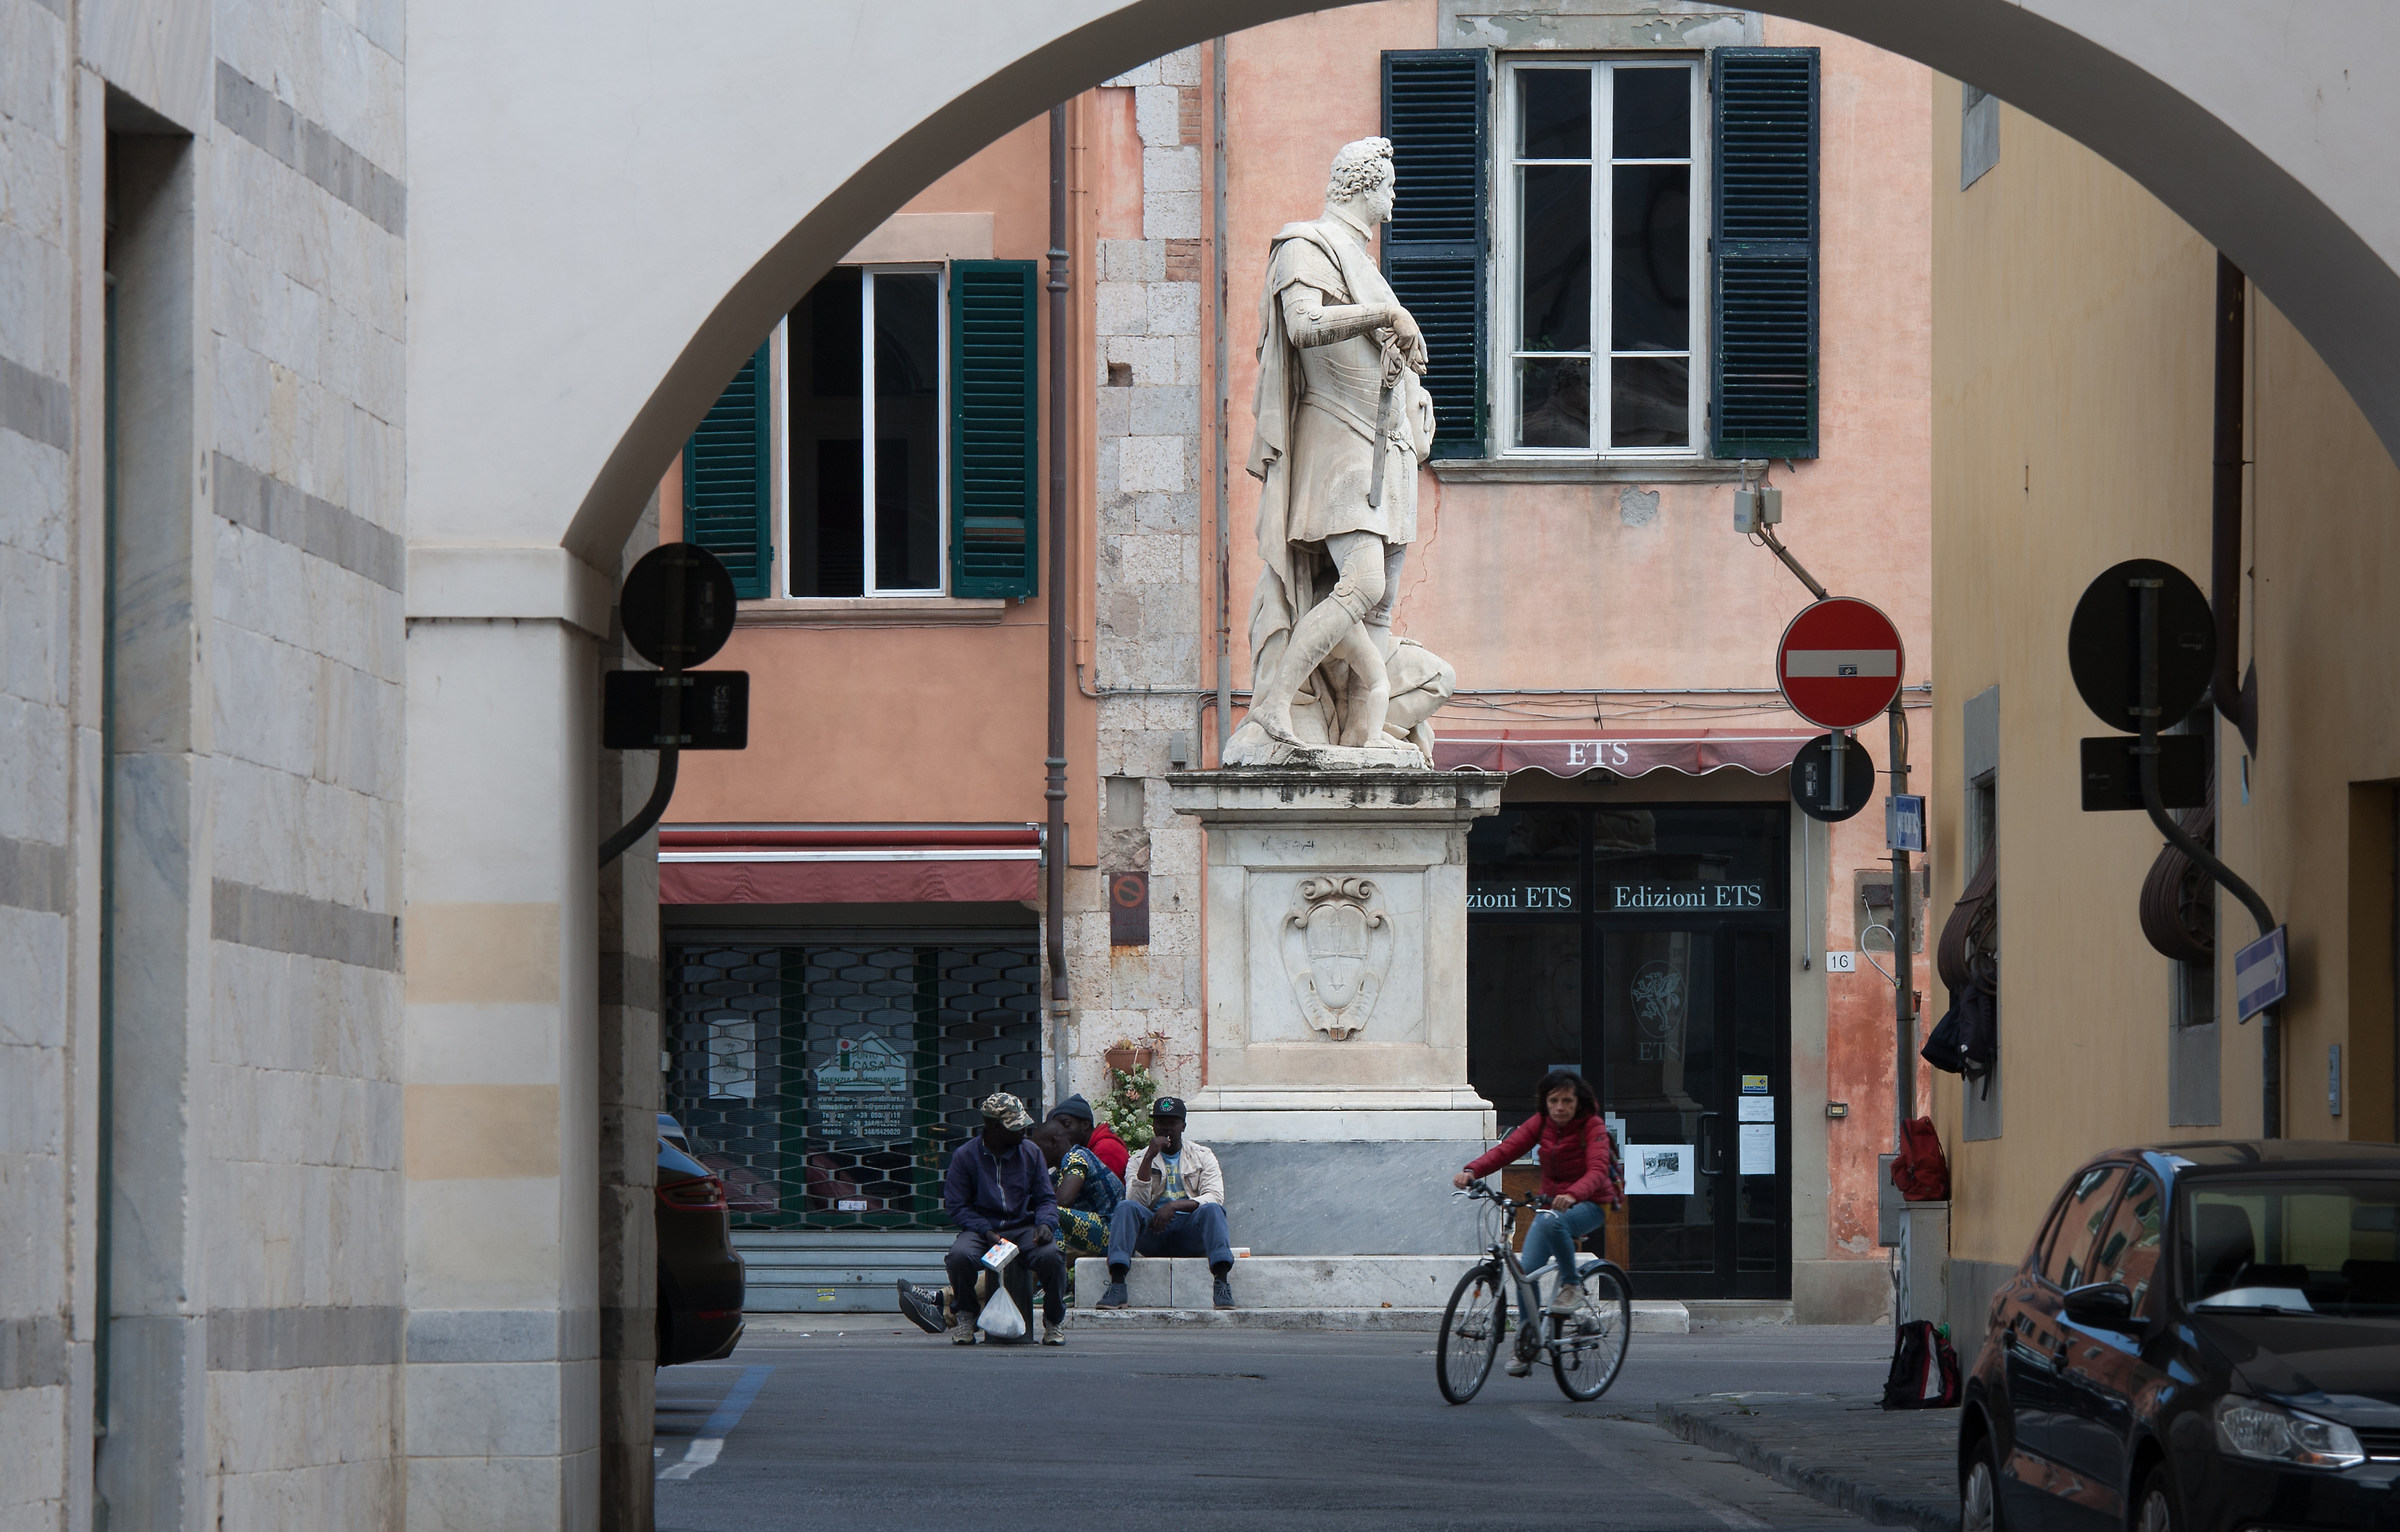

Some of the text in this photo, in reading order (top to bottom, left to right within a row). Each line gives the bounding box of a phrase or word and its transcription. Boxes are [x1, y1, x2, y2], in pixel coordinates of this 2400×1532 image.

[1566, 742, 1629, 766] ETS
[1525, 886, 1572, 908] ETS
[1614, 885, 1762, 908] Edizioni ETS
[1832, 954, 1849, 969] 16
[852, 1051, 878, 1060] PUNTO
[1637, 1042, 1680, 1061] ETS
[852, 1060, 886, 1072] CASA
